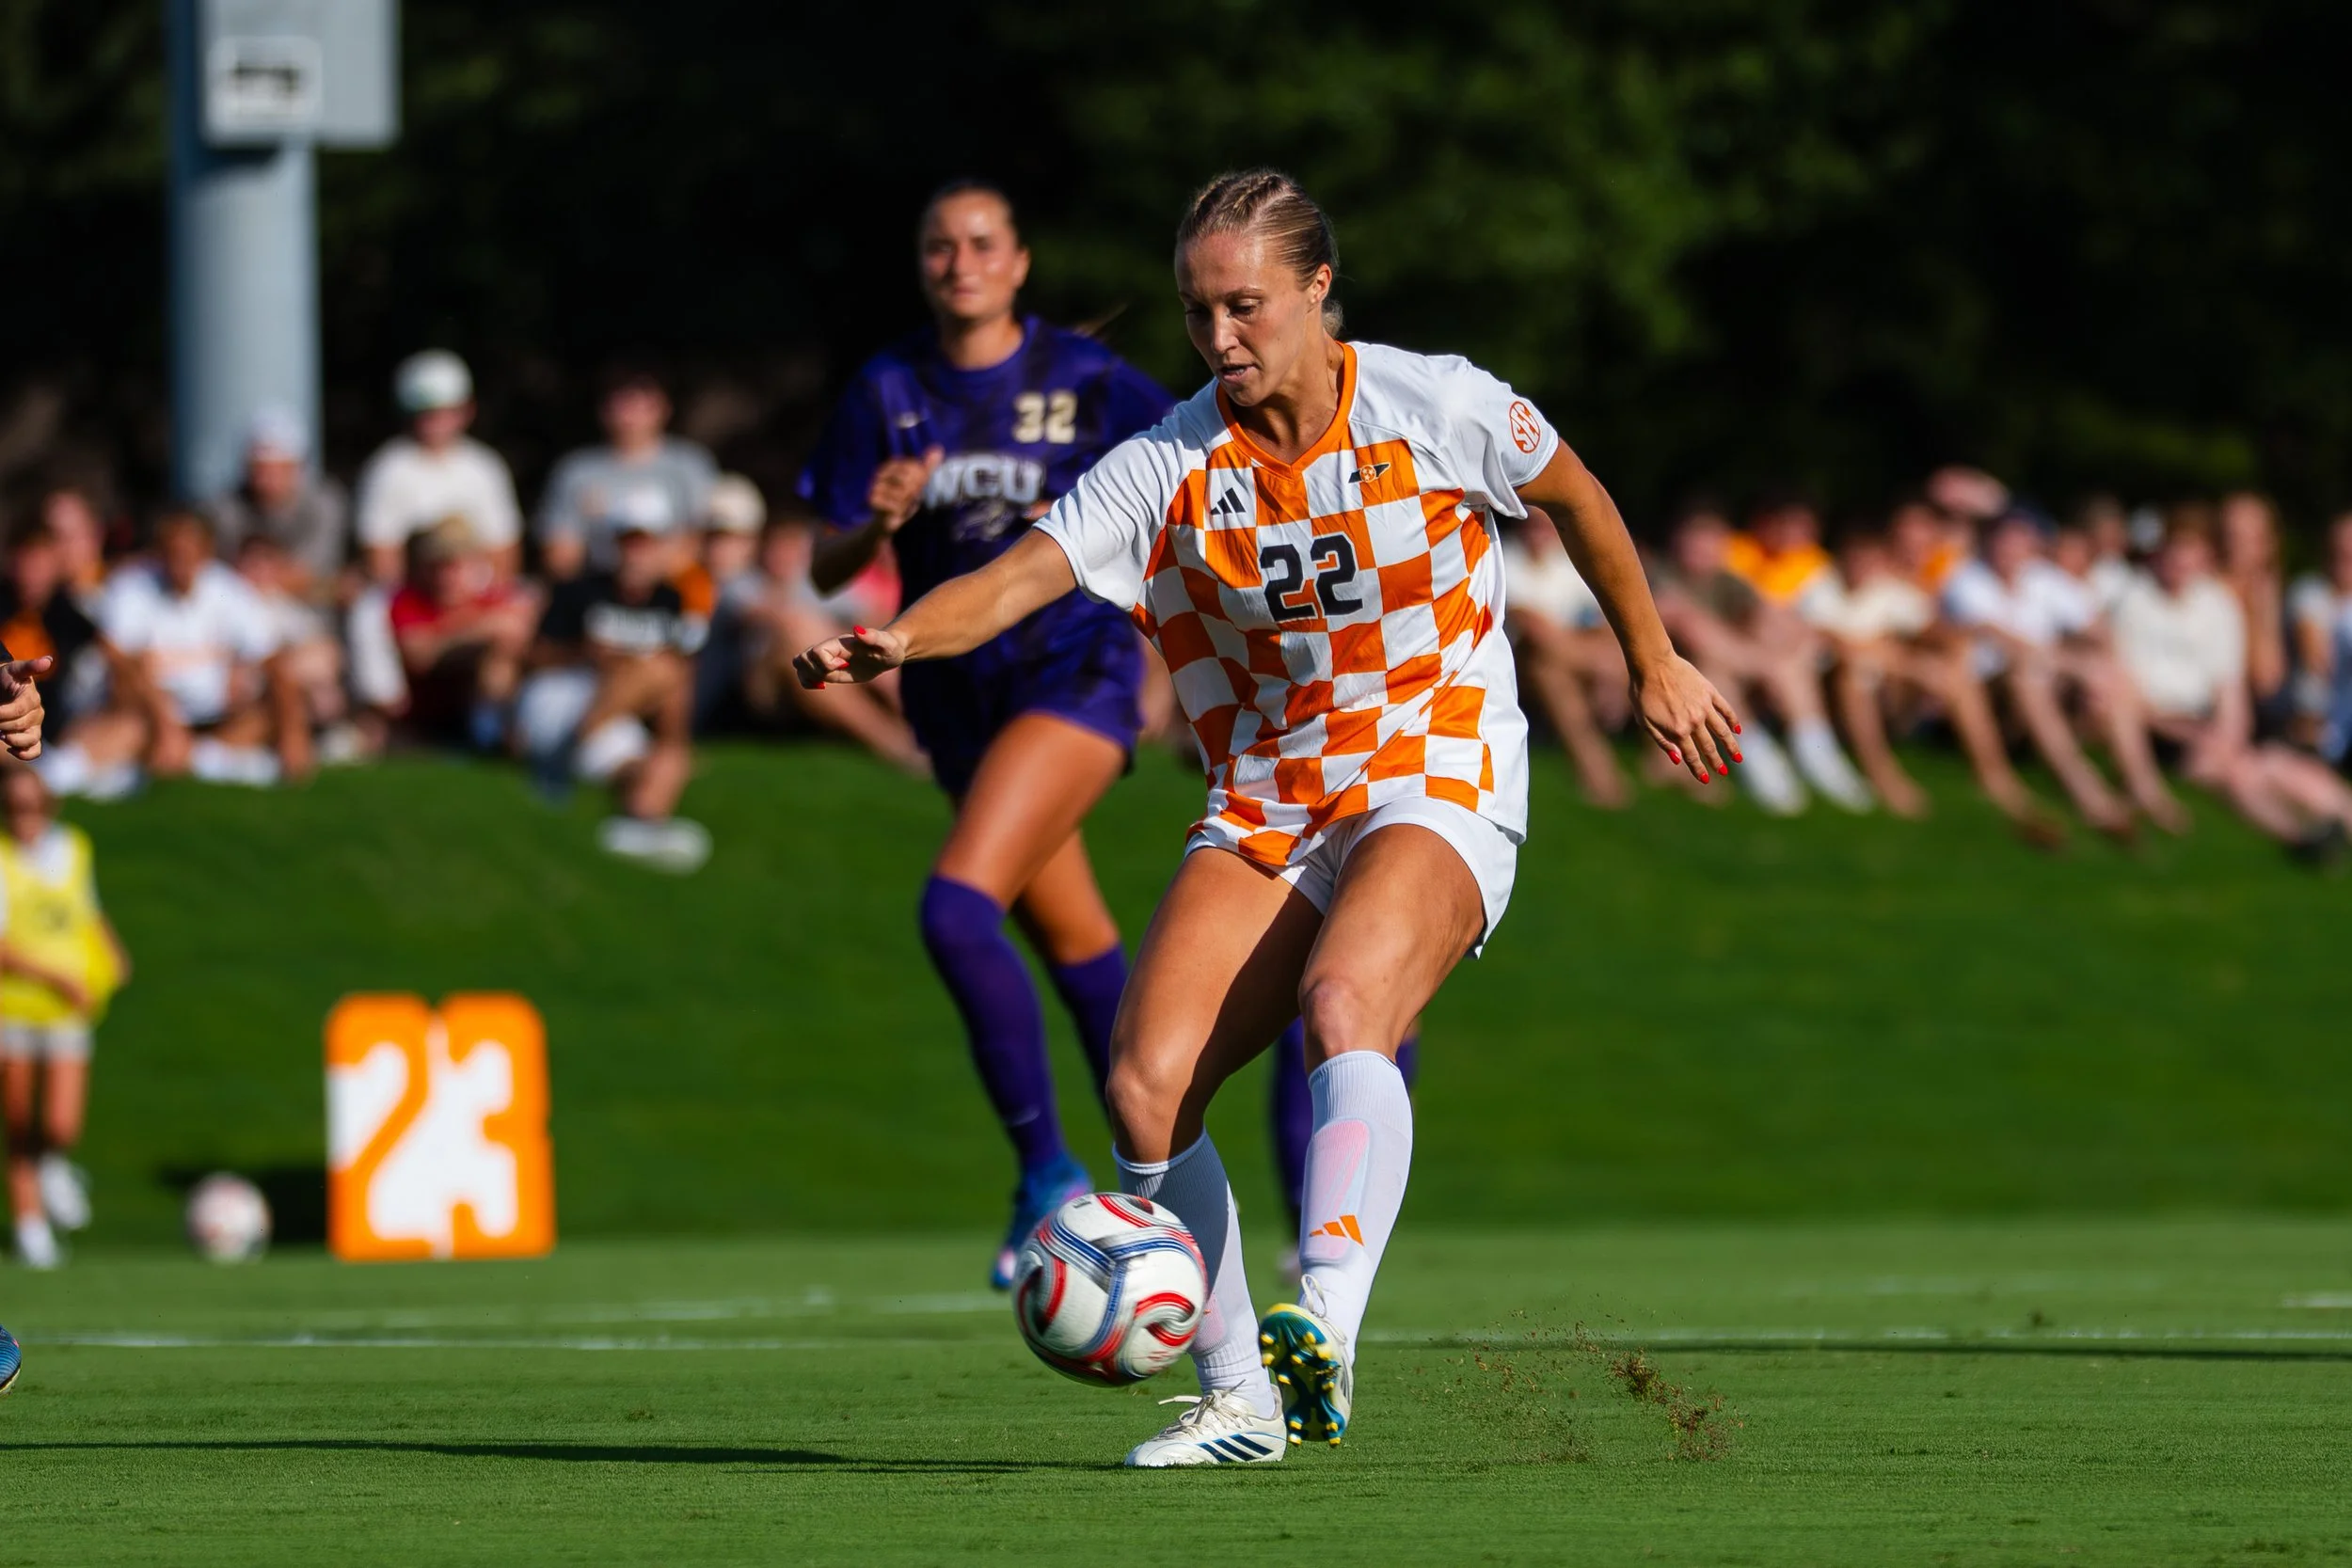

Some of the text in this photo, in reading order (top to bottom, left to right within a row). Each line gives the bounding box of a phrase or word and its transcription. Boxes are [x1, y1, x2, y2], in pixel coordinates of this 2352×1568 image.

[1012, 389, 1077, 444] 32
[1509, 401, 1540, 453] SEC
[1259, 533, 1363, 622] 22
[326, 991, 555, 1262] 23
